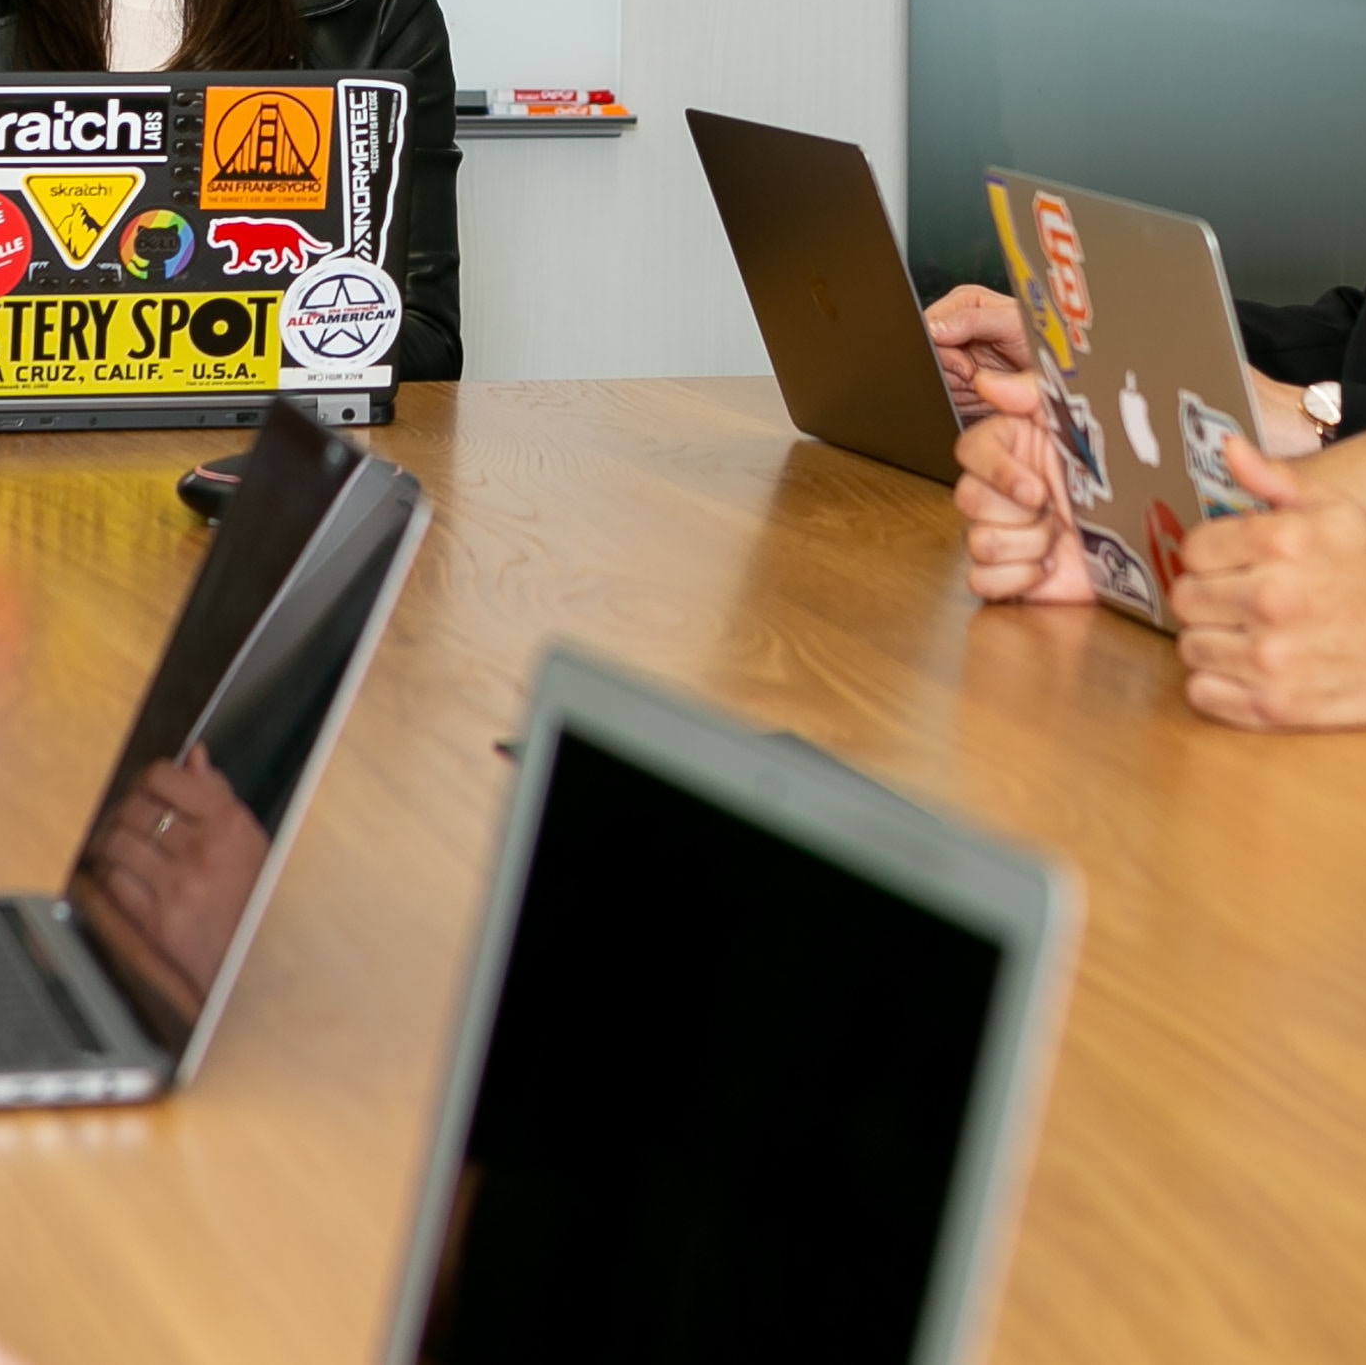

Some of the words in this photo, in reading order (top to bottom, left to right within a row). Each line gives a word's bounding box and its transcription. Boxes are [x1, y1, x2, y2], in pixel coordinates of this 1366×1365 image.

[143, 111, 163, 151] LABS
[349, 90, 372, 226] NORMATEC
[206, 181, 233, 193] SAN
[235, 181, 322, 193] FRANPSYCHO
[127, 296, 277, 360] SPOT
[316, 308, 396, 325] AMERICAN
[15, 365, 85, 384] CRUZ,
[94, 363, 163, 381] CALIF.
[192, 363, 257, 380] U.S.A.
